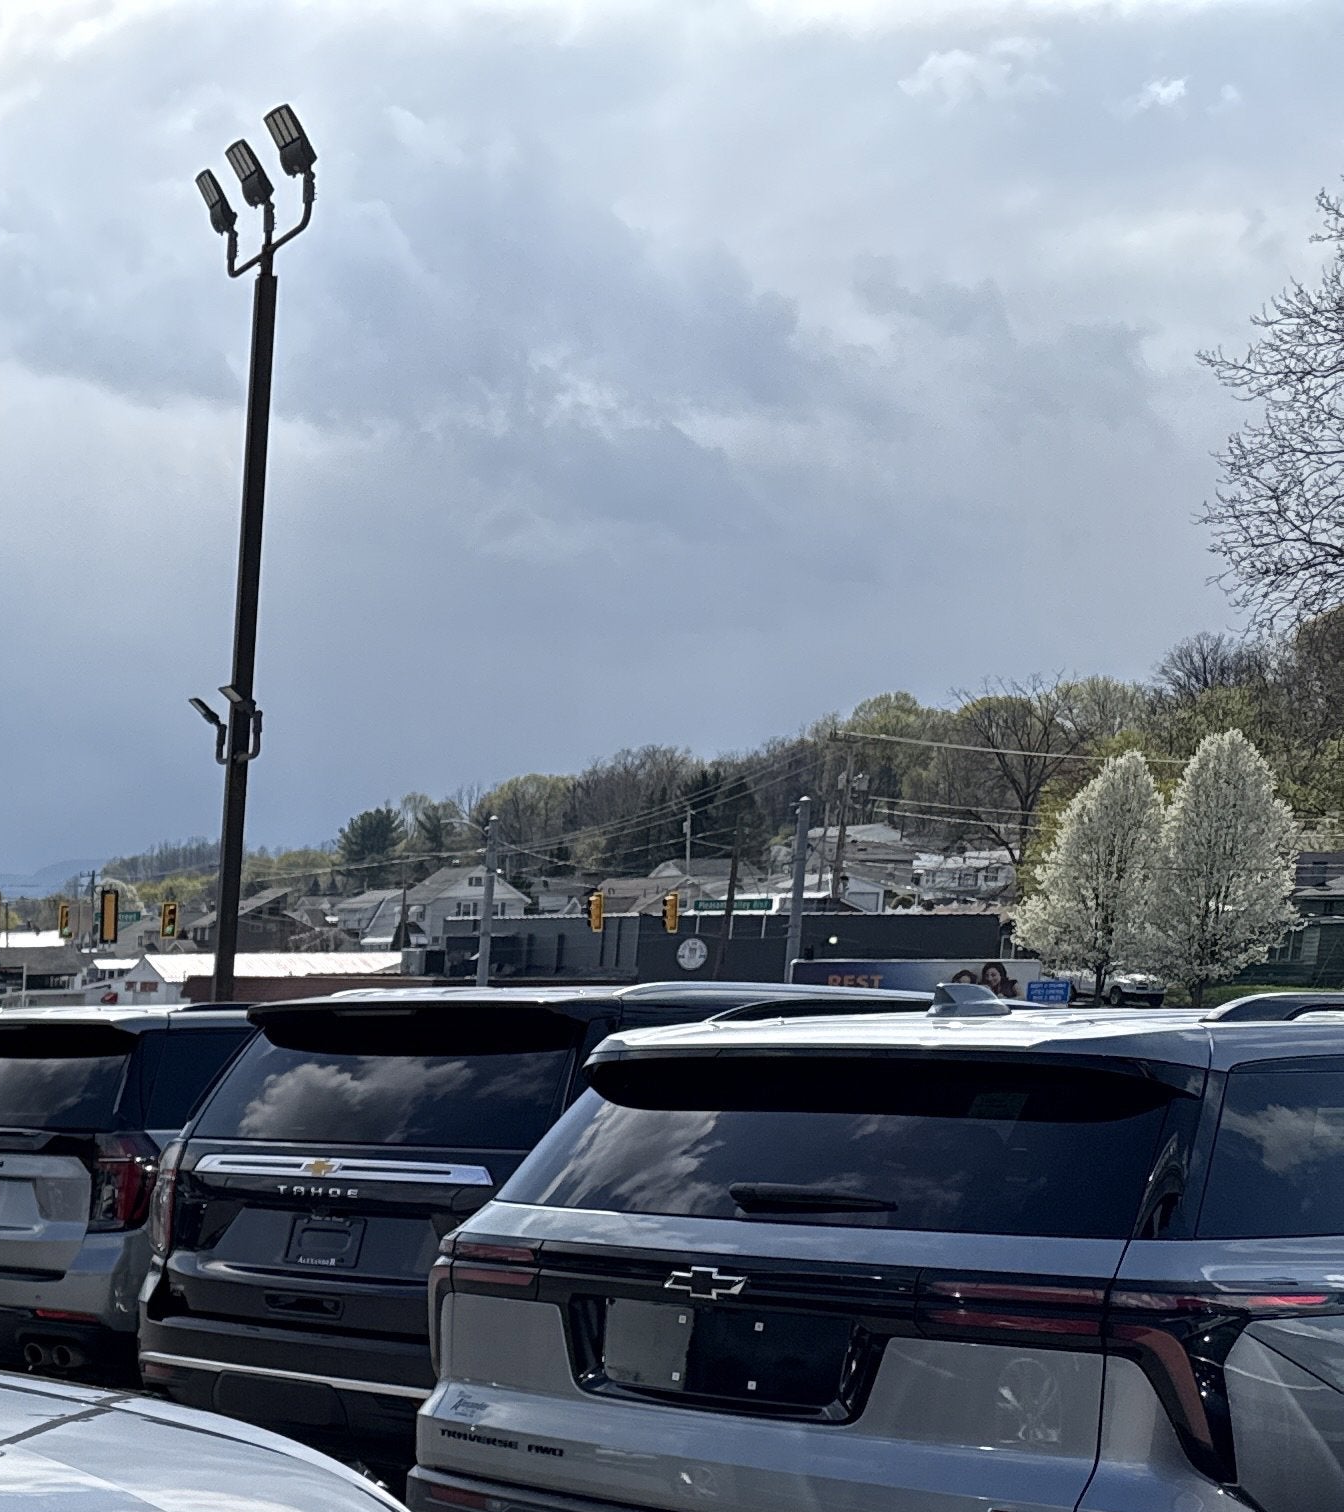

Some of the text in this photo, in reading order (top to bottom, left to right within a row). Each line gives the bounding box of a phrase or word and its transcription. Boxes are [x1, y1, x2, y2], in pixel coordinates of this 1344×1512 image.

[277, 1185, 359, 1198] TAHOE
[440, 1428, 564, 1457] TRAVERSE AWD
